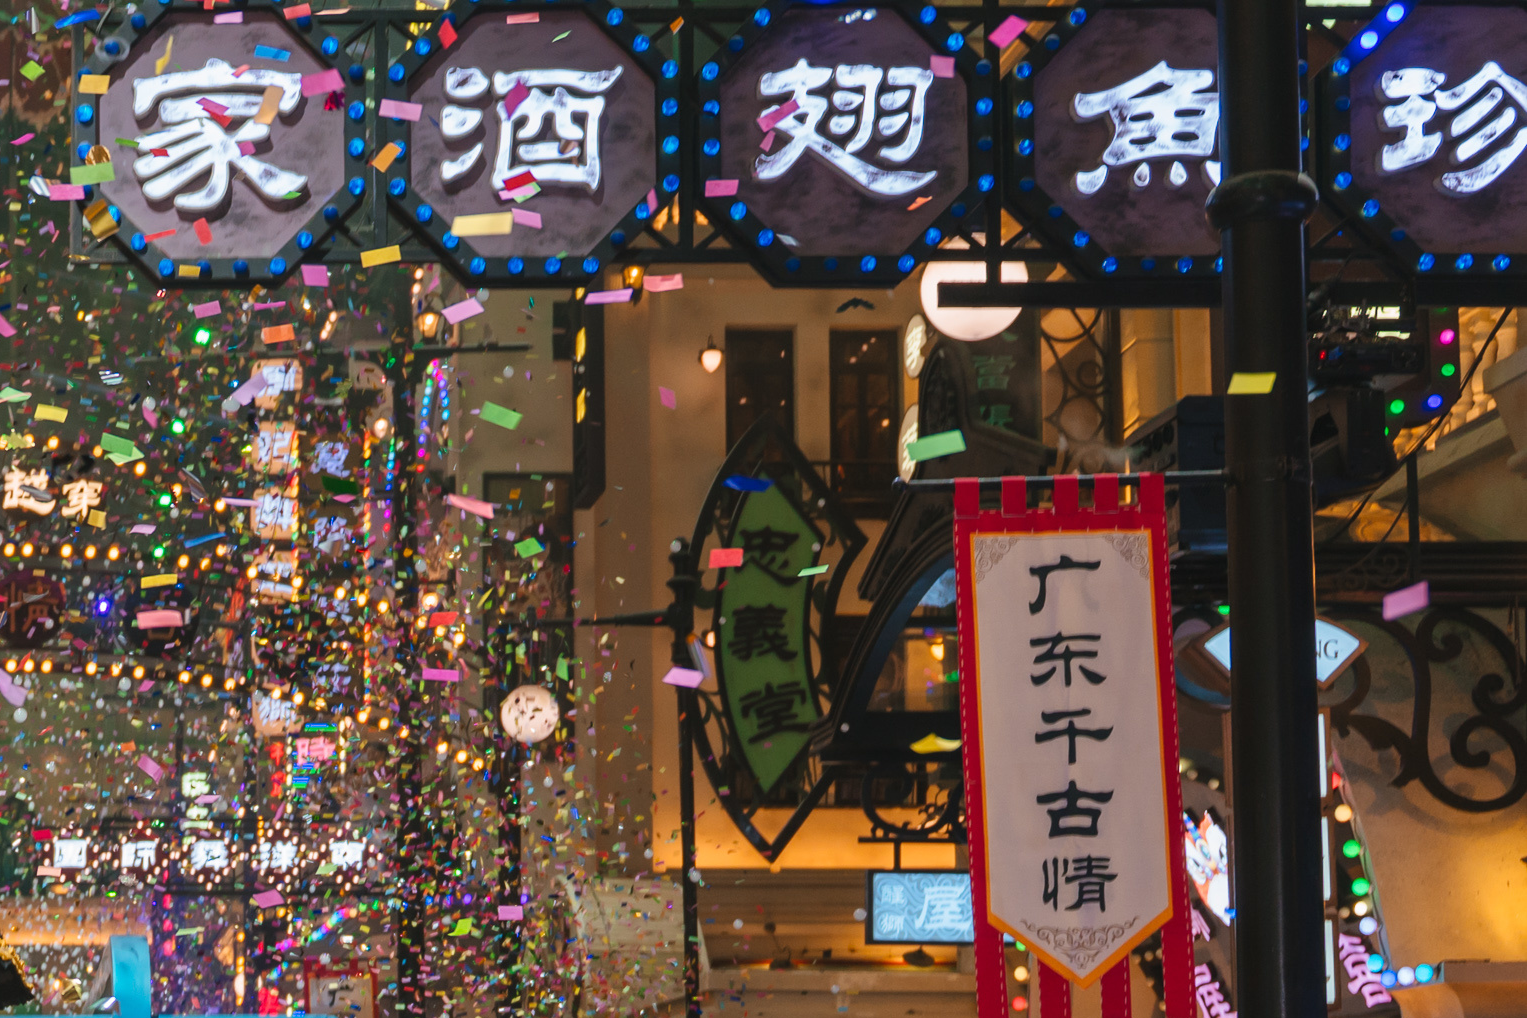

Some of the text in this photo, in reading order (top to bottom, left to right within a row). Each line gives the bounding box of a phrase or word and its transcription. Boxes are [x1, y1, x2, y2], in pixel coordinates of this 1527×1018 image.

[728, 525, 812, 745] 忠義堂
[1028, 554, 1119, 914] 广东千古情
